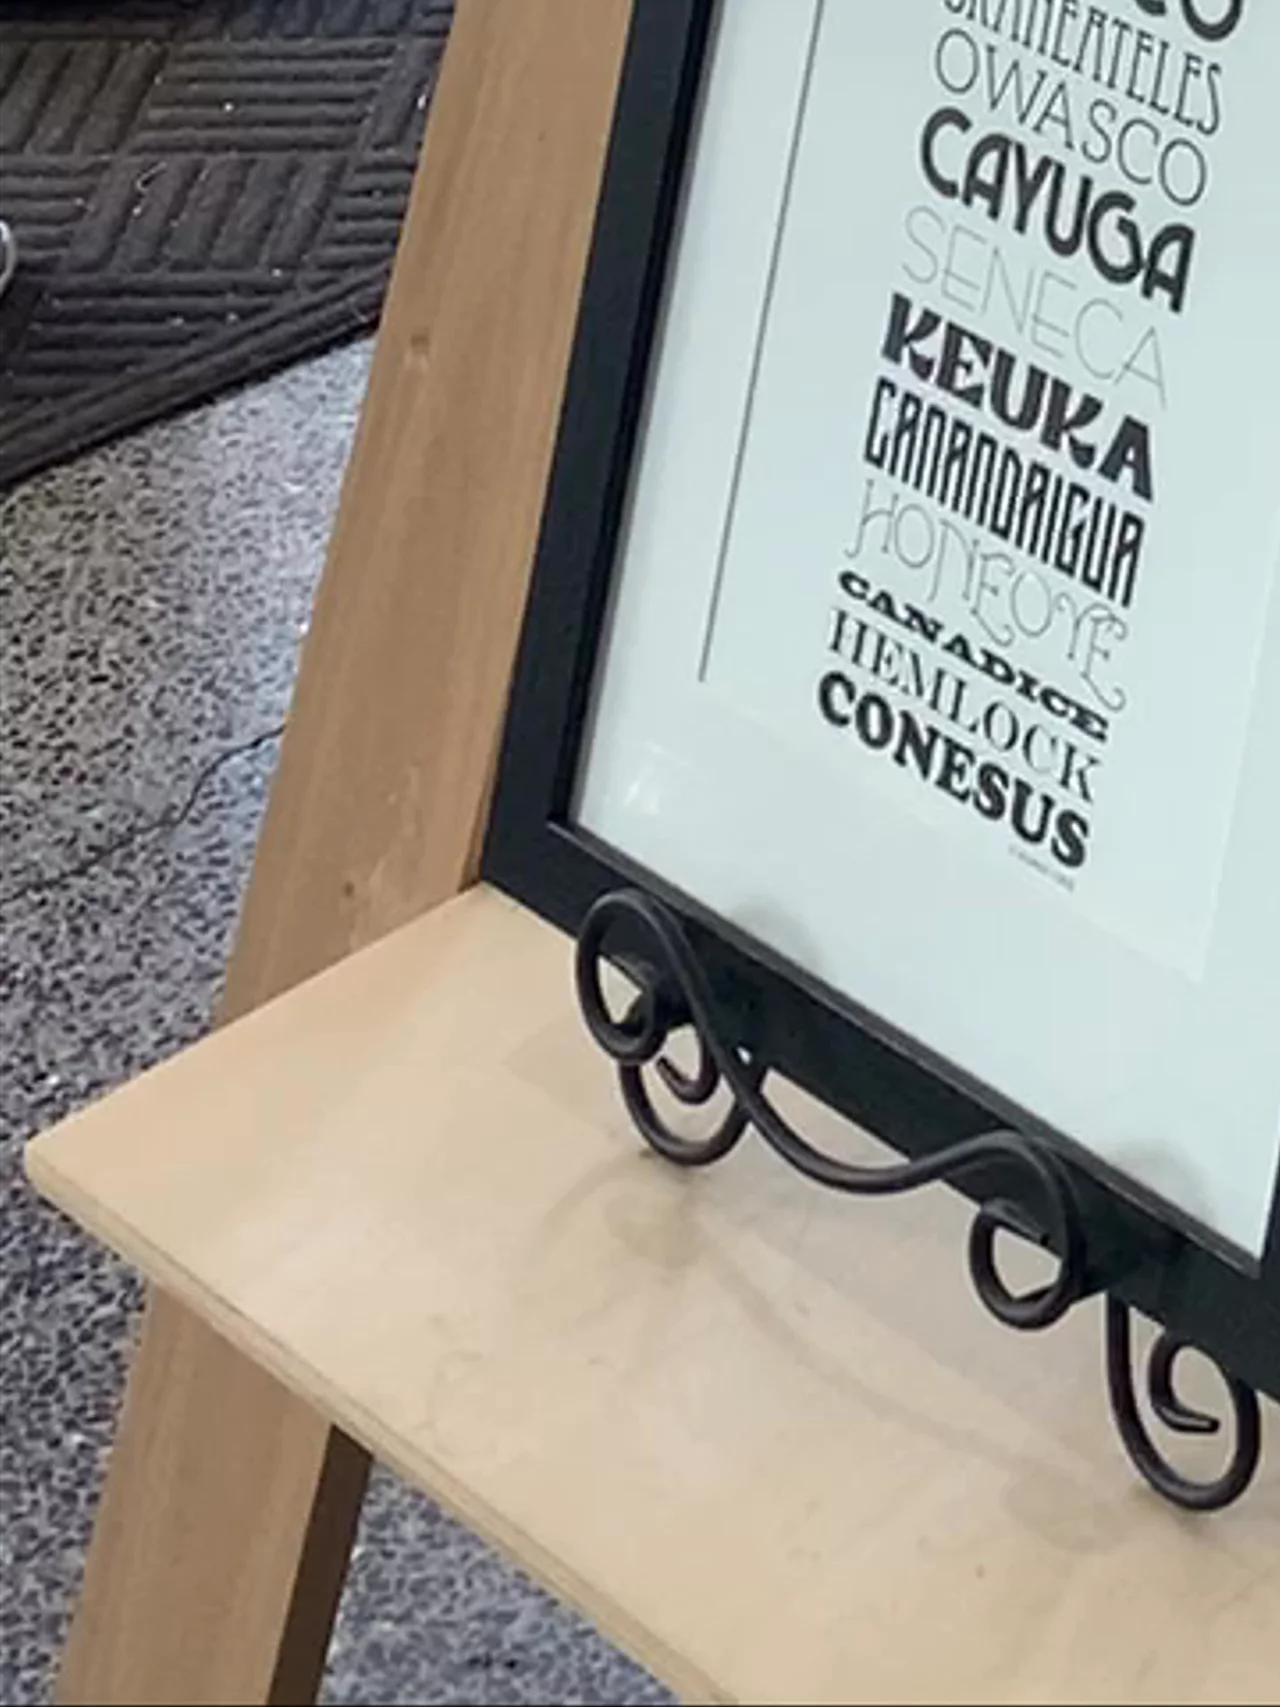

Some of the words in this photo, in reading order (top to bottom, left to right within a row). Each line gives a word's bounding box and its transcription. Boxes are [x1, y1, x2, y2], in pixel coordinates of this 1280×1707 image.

[920, 105, 1198, 314] CAYUGA
[934, 28, 1208, 207] OWASCO
[880, 291, 1155, 502] KEUKA
[900, 204, 1167, 411] SENECA
[845, 479, 1127, 712] HONEOYE
[863, 375, 1147, 609] CANANDAIGUA
[827, 606, 1101, 805] HEMLOCK
[838, 570, 1110, 741] CANADICE
[818, 670, 1090, 869] CONESUS
